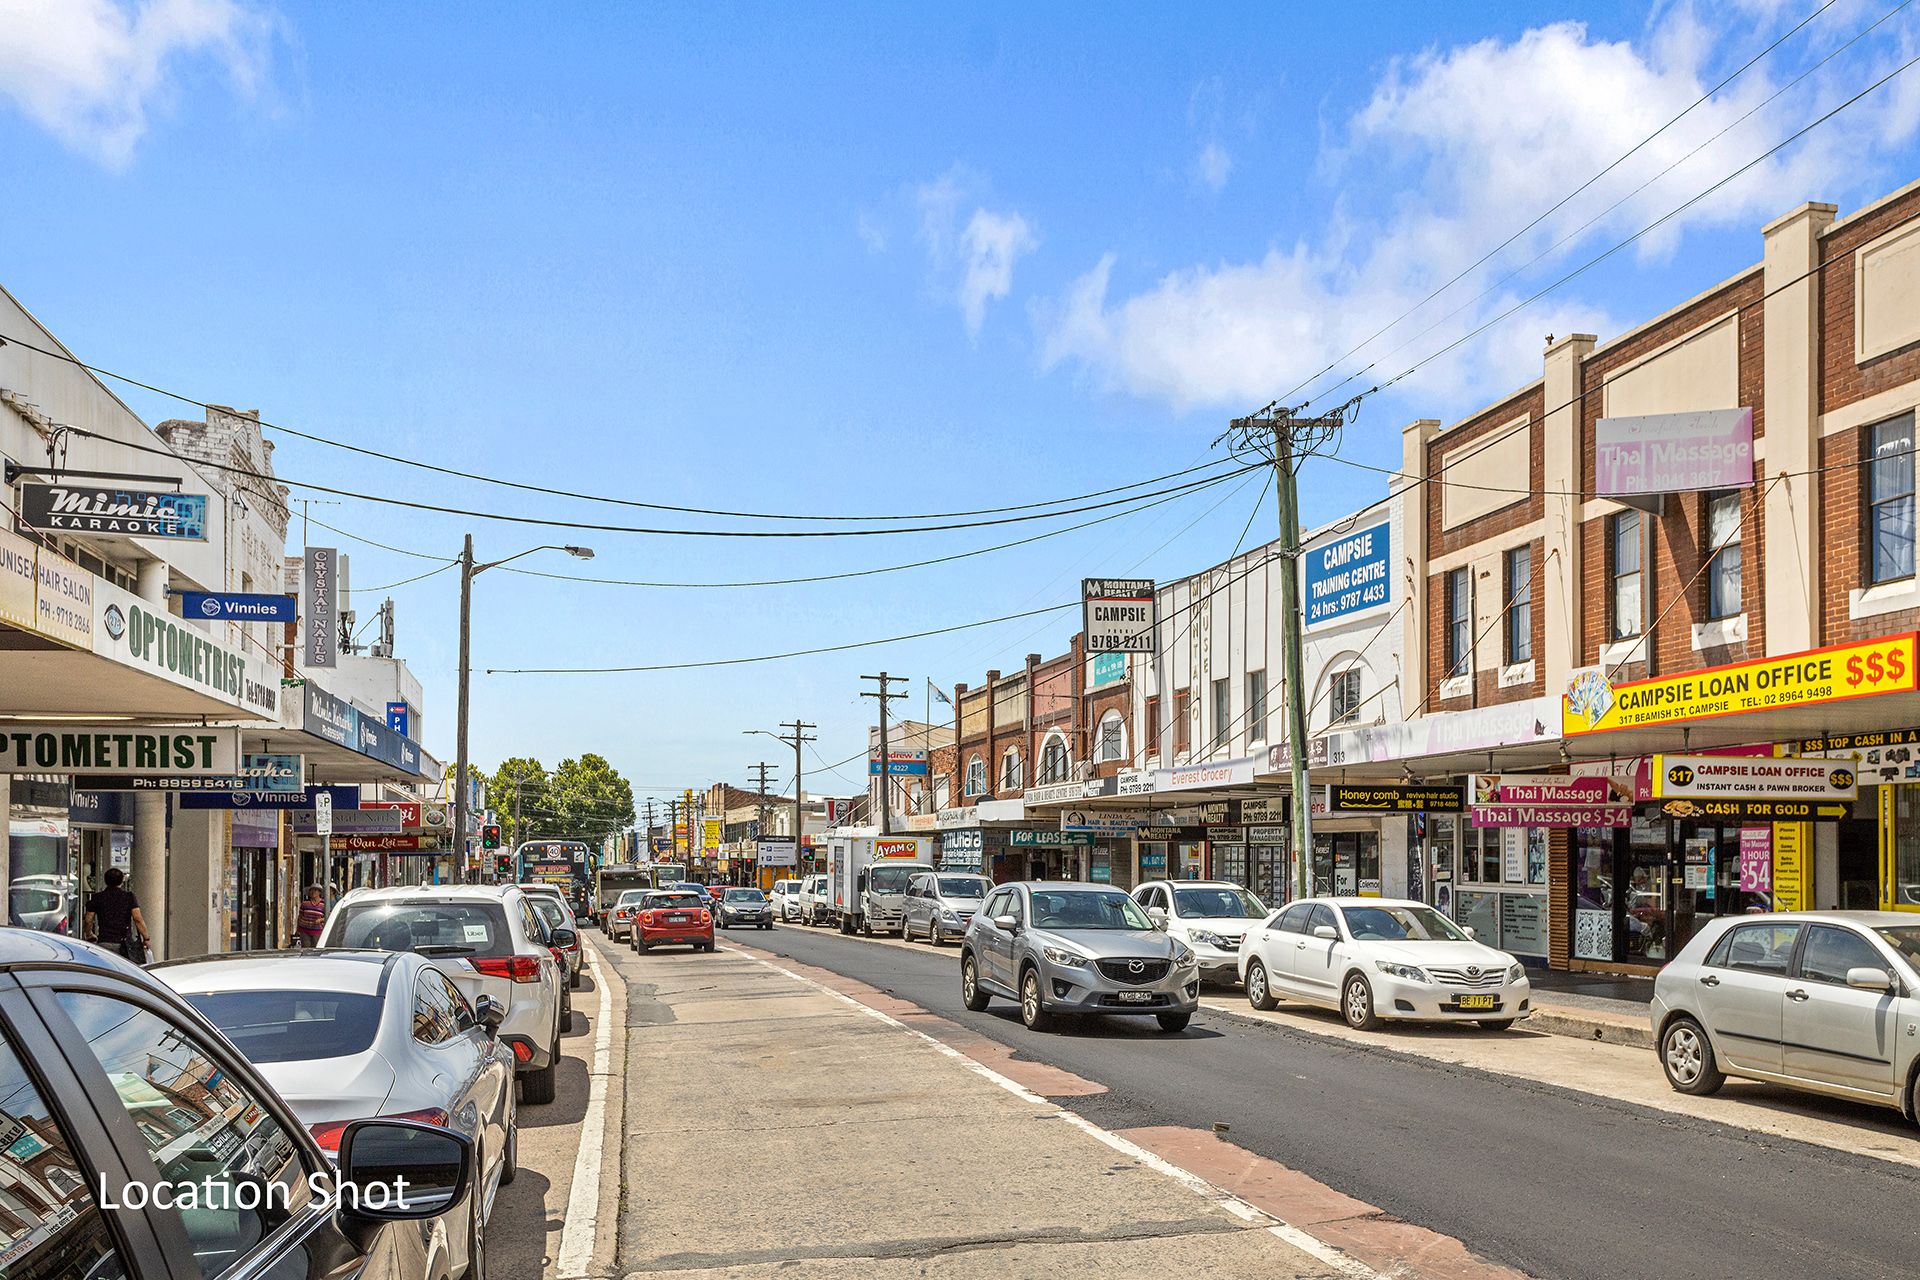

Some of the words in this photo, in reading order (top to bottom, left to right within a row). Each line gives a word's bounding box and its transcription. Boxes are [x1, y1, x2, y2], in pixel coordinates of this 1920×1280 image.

[1600, 447, 1645, 467] Thai
[1650, 440, 1749, 466] Massage
[49, 488, 180, 519] Mimic
[51, 516, 178, 534] KARAOKE
[1323, 533, 1373, 571] CAMPSIE
[39, 564, 61, 593] HAIR
[62, 576, 91, 606] SALON
[313, 551, 329, 614] CRYSTAL
[1104, 581, 1151, 590] MONTANA
[1311, 571, 1350, 599] TRAINING
[1351, 559, 1386, 587] CENTRE
[1104, 589, 1138, 598] REALTY
[1311, 602, 1320, 620] 24
[1322, 600, 1339, 616] hrs:
[1340, 590, 1362, 611] 9787
[1363, 583, 1385, 604] 4433
[225, 601, 278, 615] Vinnies
[1095, 606, 1146, 622] CAMPSIE
[56, 606, 73, 627] 9718
[1202, 573, 1210, 675] HOUSE
[313, 619, 328, 664] NAILS
[1091, 635, 1119, 649] 9789
[1123, 635, 1151, 649] 2211
[129, 604, 246, 700] OPTOMETRIST
[1619, 683, 1692, 711] CAMPSIE
[1699, 673, 1749, 698] LOAN
[1756, 659, 1832, 690] OFFICE
[1846, 647, 1906, 689] $$$
[1619, 713, 1633, 725] 317
[1635, 708, 1672, 723] BEAMISH
[1689, 701, 1729, 715] CAMPSIE
[1740, 697, 1762, 708] TEL:
[1764, 694, 1776, 705] 02
[1779, 690, 1804, 703] 8964
[1807, 686, 1832, 699] 9498
[1463, 713, 1531, 742] Massage
[1805, 739, 1823, 751] $$$
[1828, 737, 1849, 749] TOP
[1855, 734, 1884, 747] CASH
[1890, 732, 1902, 744] IN
[1333, 752, 1346, 763] 313
[1120, 776, 1138, 784] CAMPSIE
[1172, 770, 1200, 785] Everest
[1201, 767, 1233, 783] Grocery
[1669, 771, 1693, 782] 317
[1697, 765, 1748, 776] CAMPSIE
[1751, 766, 1782, 777] LOAN
[1784, 767, 1825, 777] OFFICE
[1830, 773, 1853, 786] $$$
[133, 778, 157, 788] Ph:
[159, 778, 202, 788] 8959
[206, 779, 244, 789] 5416
[1120, 785, 1128, 794] PH:
[1129, 784, 1142, 794] 9789
[1143, 783, 1154, 792] 2211
[1696, 783, 1732, 791] INSTANT
[1766, 784, 1790, 792] PAWN
[1792, 784, 1826, 792] BROKER
[256, 792, 307, 803] Vinnies
[1340, 790, 1372, 801] Honey
[1372, 790, 1400, 799] comb
[1426, 791, 1438, 799] hair
[1439, 791, 1458, 799] studio
[1507, 786, 1538, 800] Thai
[1541, 786, 1602, 803] Massage
[1243, 801, 1267, 810] CAMPSIE
[1747, 803, 1771, 815] FOR
[1775, 803, 1809, 815] GOLD
[1243, 813, 1253, 822] PH:
[1254, 812, 1268, 821] 9789
[1269, 811, 1281, 821] 2211
[1475, 808, 1512, 822] Thai
[1517, 808, 1592, 827] Massage
[1015, 832, 1033, 842] FOR
[1036, 832, 1068, 844] LEASE
[876, 843, 905, 858] AYAM
[1742, 850, 1747, 860] 1
[1747, 850, 1770, 860] HOUR
[1337, 875, 1348, 885] For
[1741, 861, 1770, 890] $54
[1337, 887, 1356, 897] Lease
[467, 930, 485, 938] Uber
